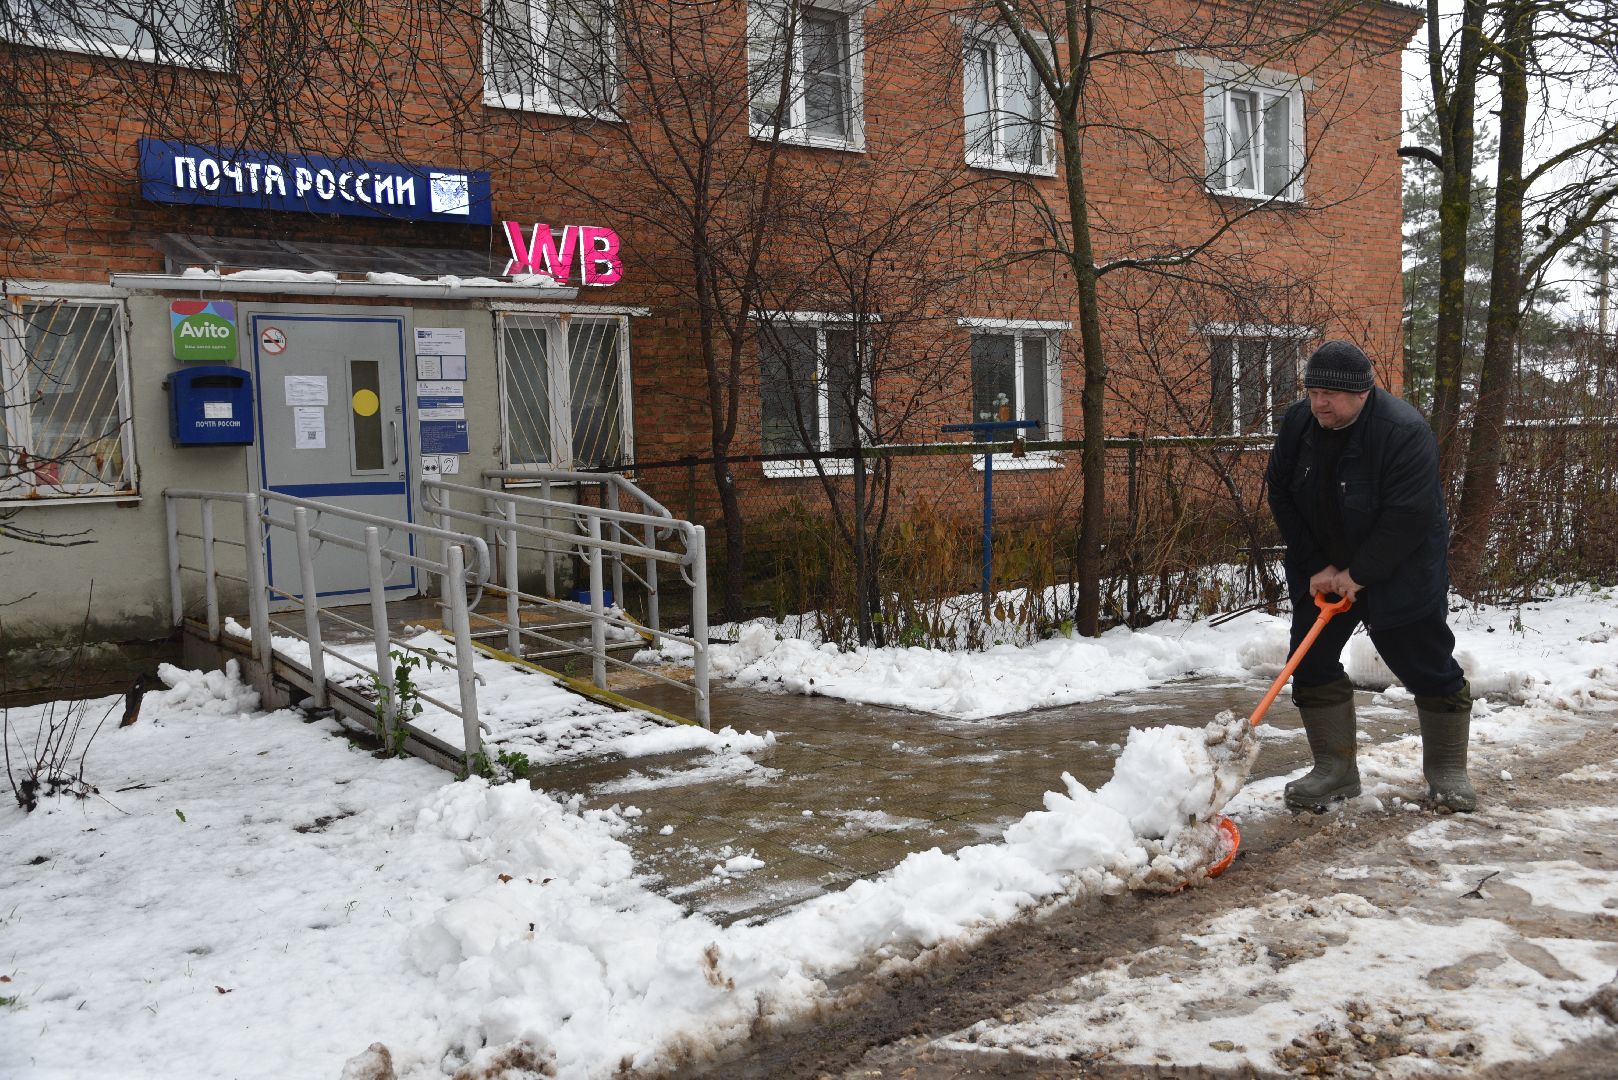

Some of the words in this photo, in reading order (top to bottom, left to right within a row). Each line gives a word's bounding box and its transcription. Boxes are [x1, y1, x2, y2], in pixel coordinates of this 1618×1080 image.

[174, 156, 286, 196] ПОЧТА
[295, 167, 416, 206] РОССИИ
[502, 220, 624, 287] WB
[180, 321, 230, 338] Avito
[195, 420, 217, 428] ПОЧТА
[217, 420, 241, 428] РОССИИ
